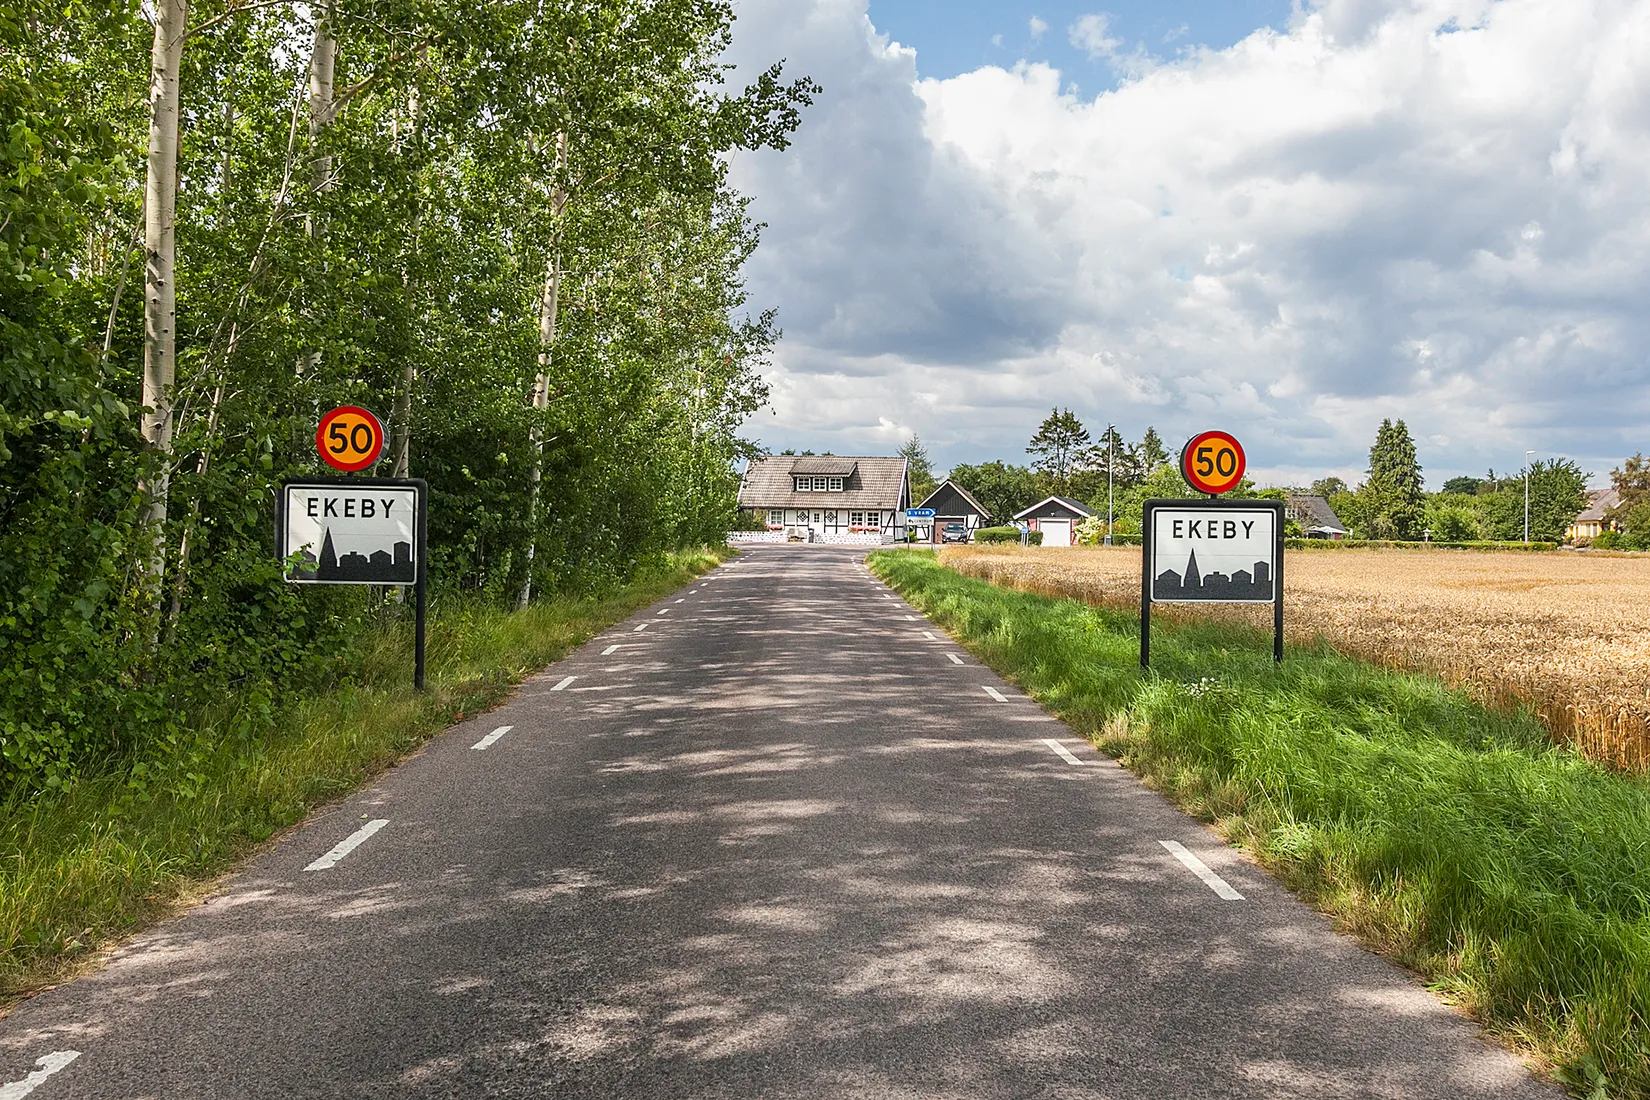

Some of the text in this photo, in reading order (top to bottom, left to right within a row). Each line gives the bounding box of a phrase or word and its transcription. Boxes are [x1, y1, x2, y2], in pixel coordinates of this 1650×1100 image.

[329, 423, 373, 454] 50
[1196, 447, 1237, 477] 50
[307, 497, 395, 518] EKEBY
[1172, 519, 1255, 539] EKEBY
